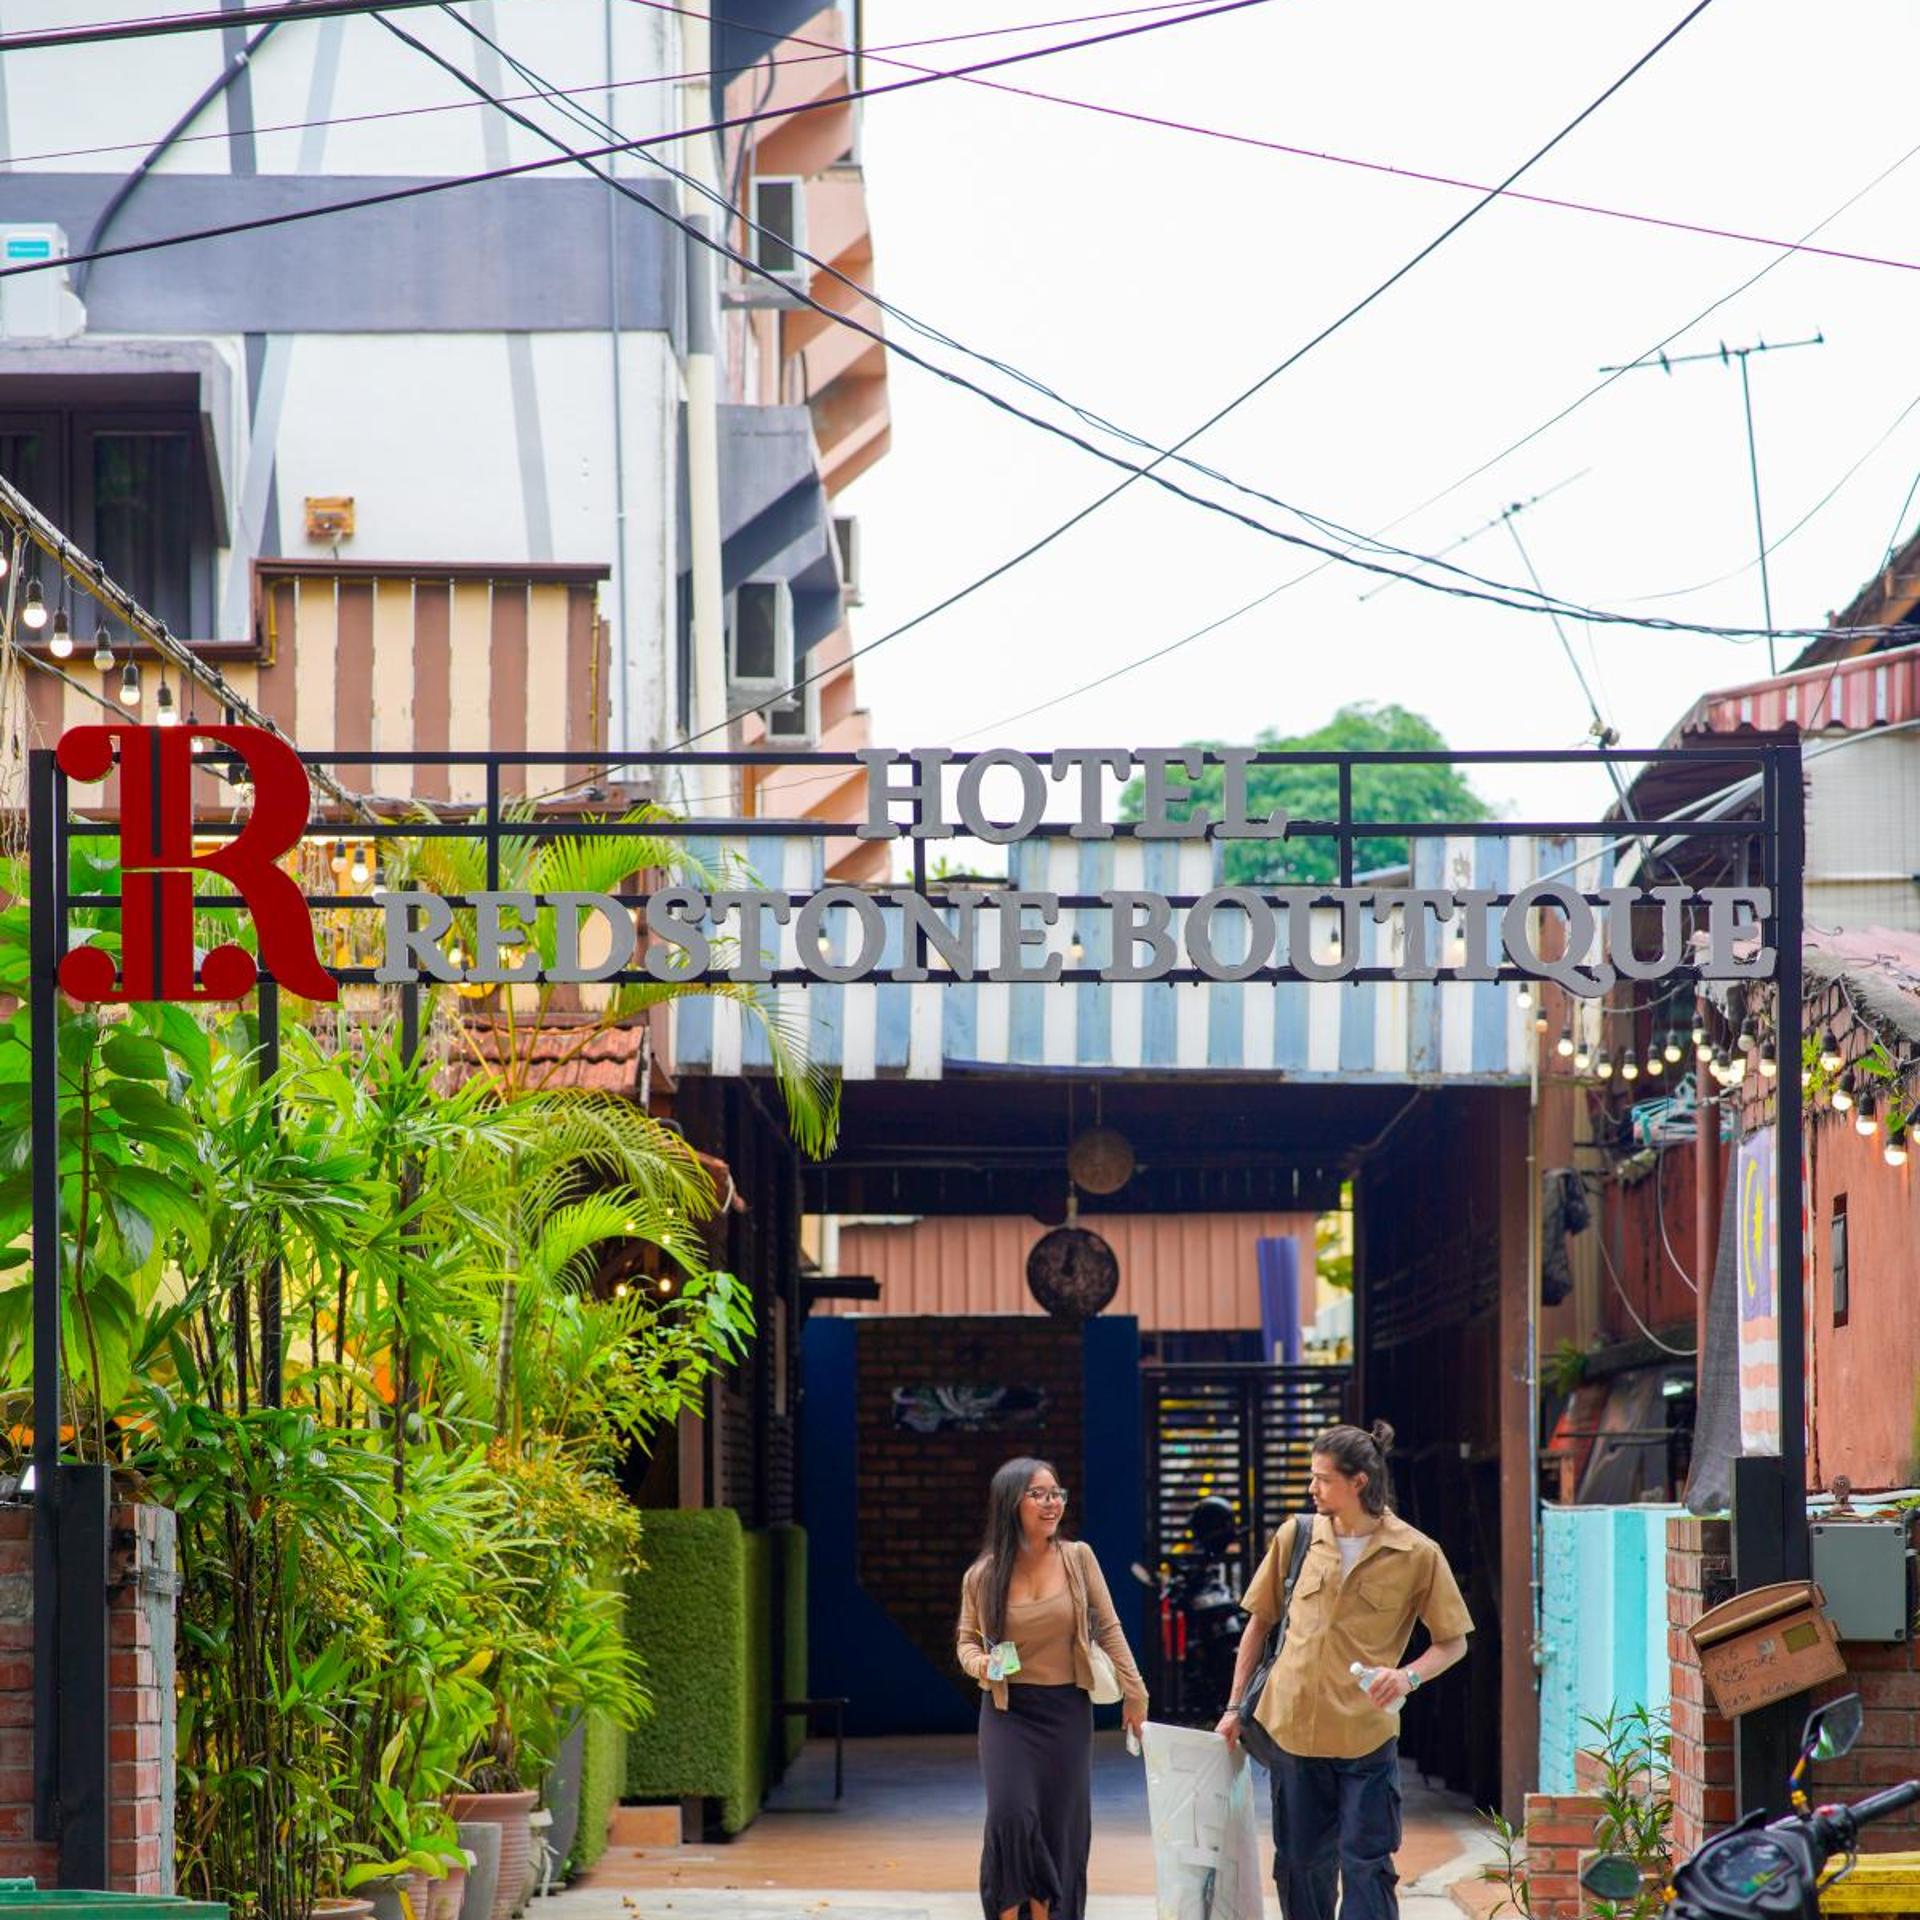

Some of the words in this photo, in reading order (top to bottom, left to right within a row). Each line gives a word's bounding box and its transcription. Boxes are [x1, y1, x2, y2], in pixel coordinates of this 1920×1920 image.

[856, 747, 1287, 845] HOTEL
[57, 725, 338, 1003] R
[373, 886, 1064, 984] REDSTONE
[1100, 881, 1777, 998] BOUTIQUE
